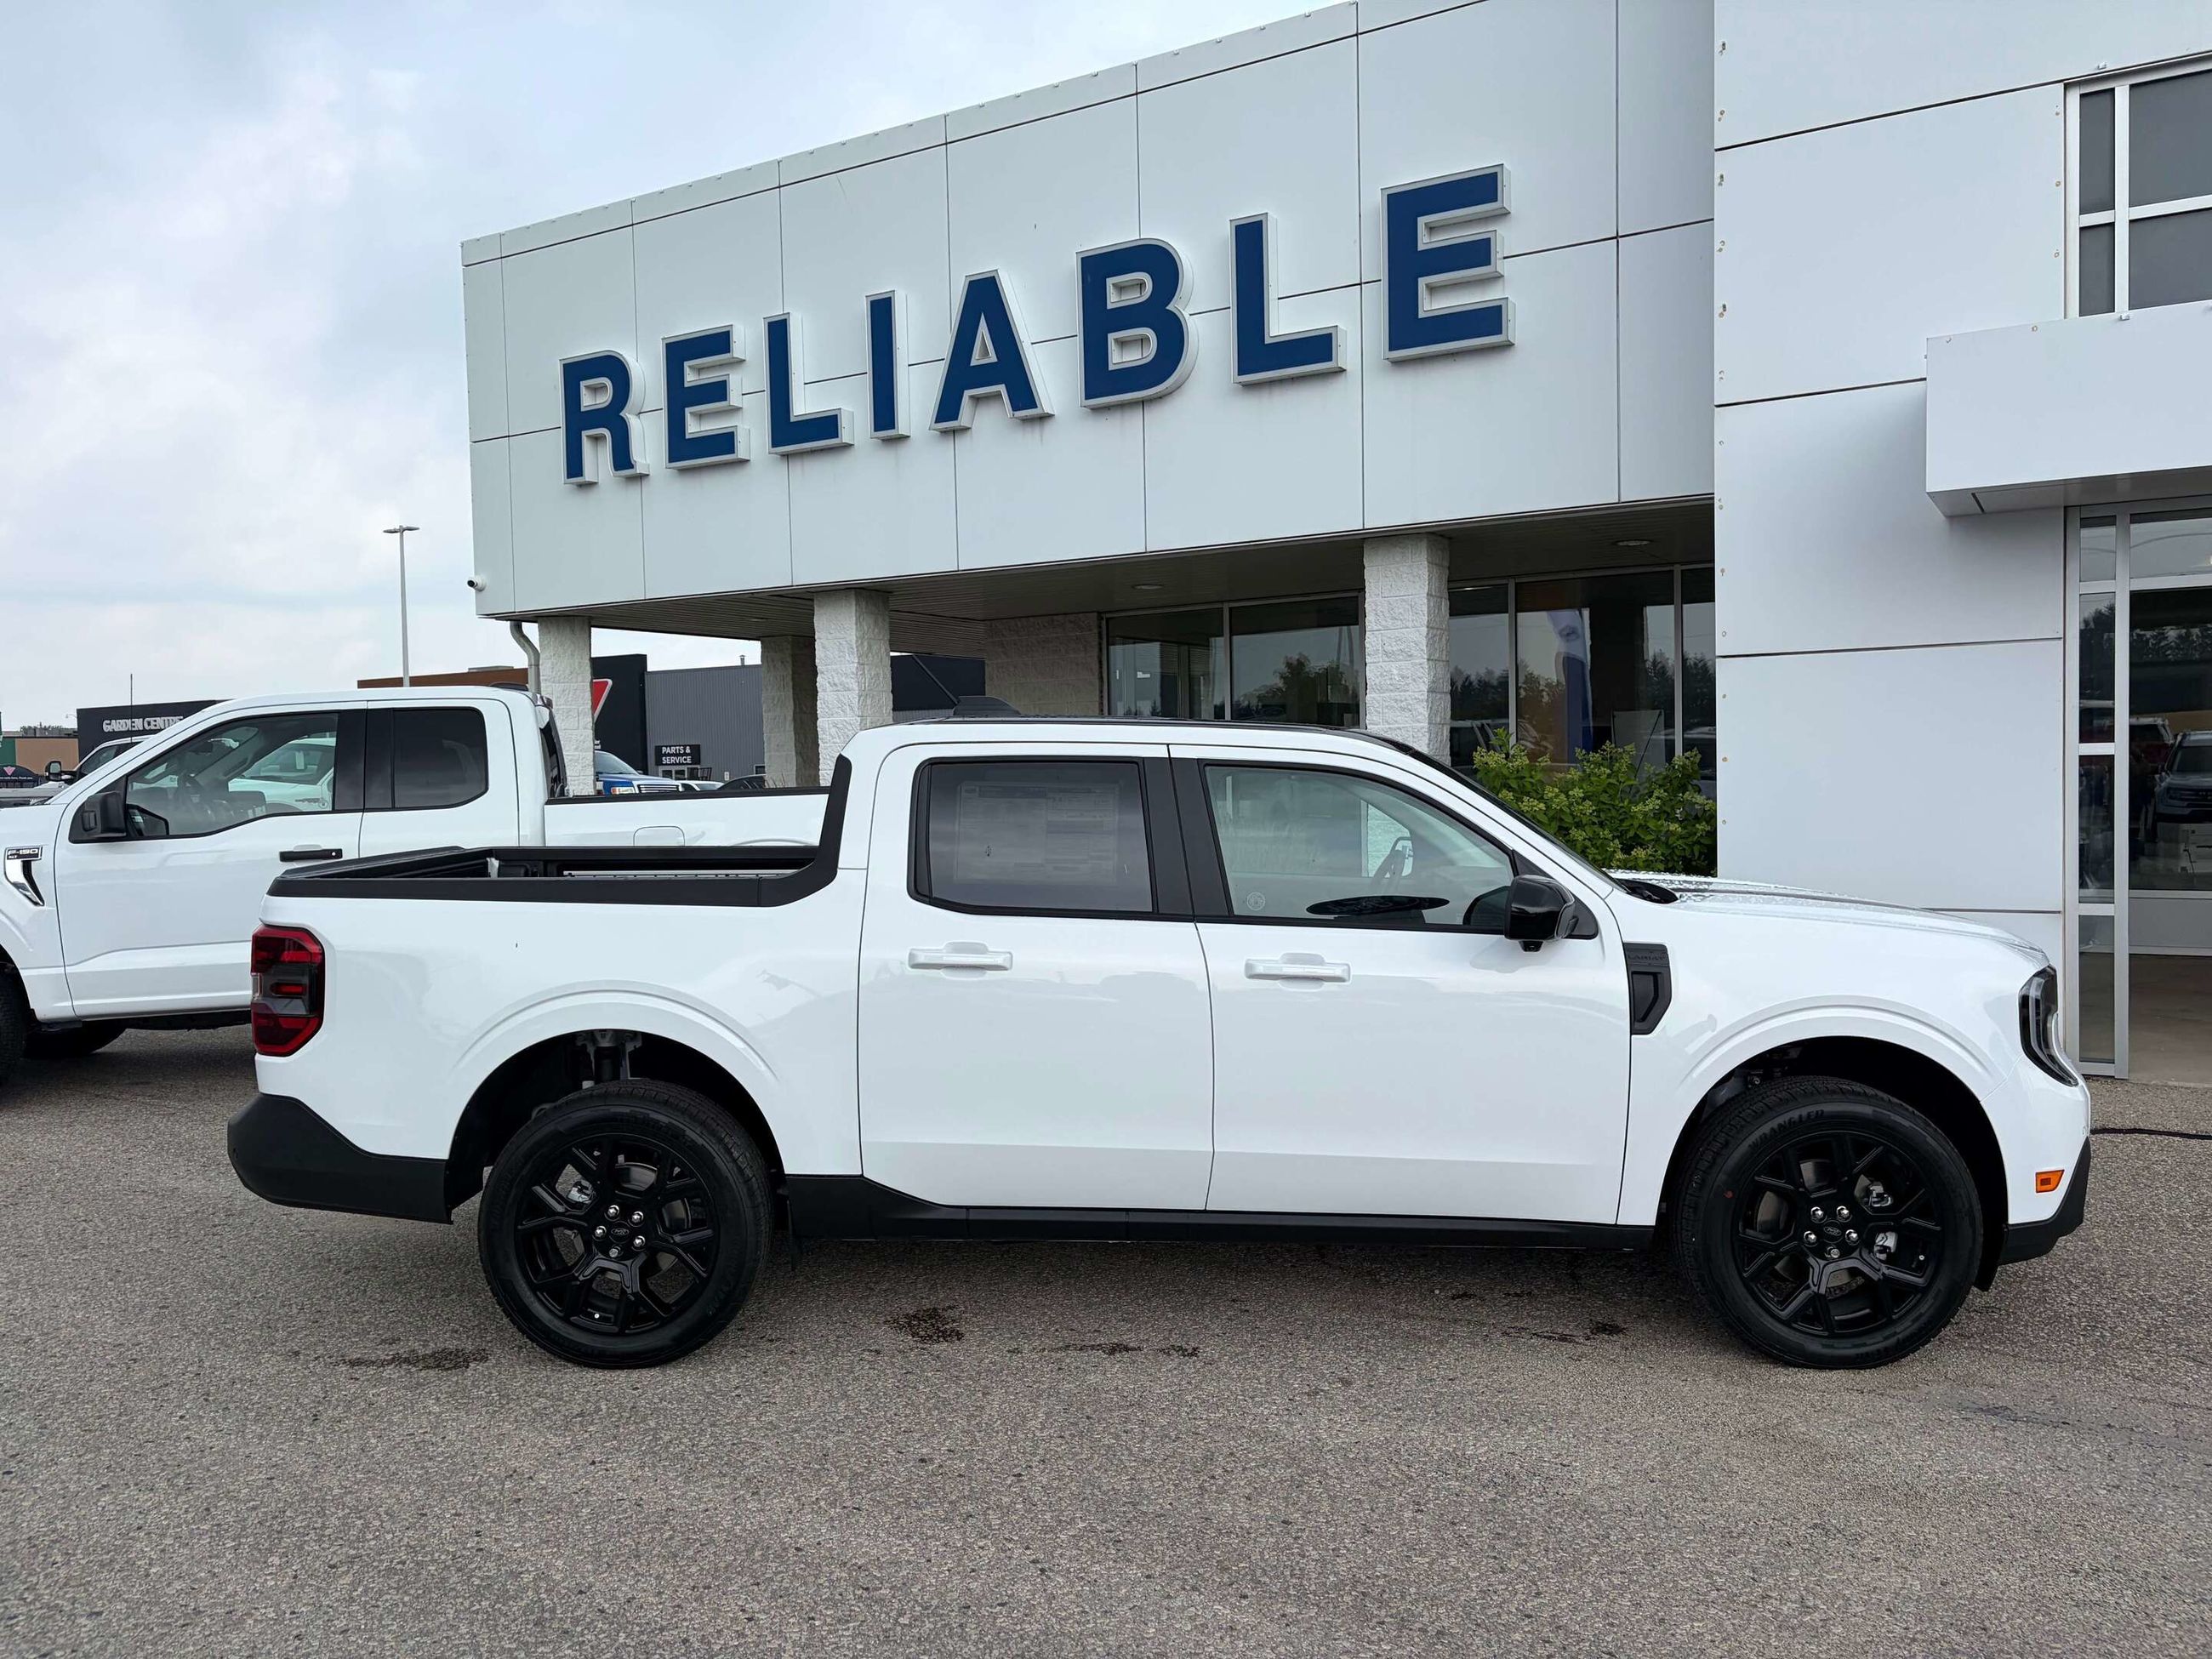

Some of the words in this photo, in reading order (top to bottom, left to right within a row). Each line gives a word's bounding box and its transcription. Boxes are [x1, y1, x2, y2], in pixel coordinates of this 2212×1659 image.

[559, 163, 1516, 487] RELIABLE
[103, 718, 143, 732] GARDEN
[144, 716, 183, 729] CENTR
